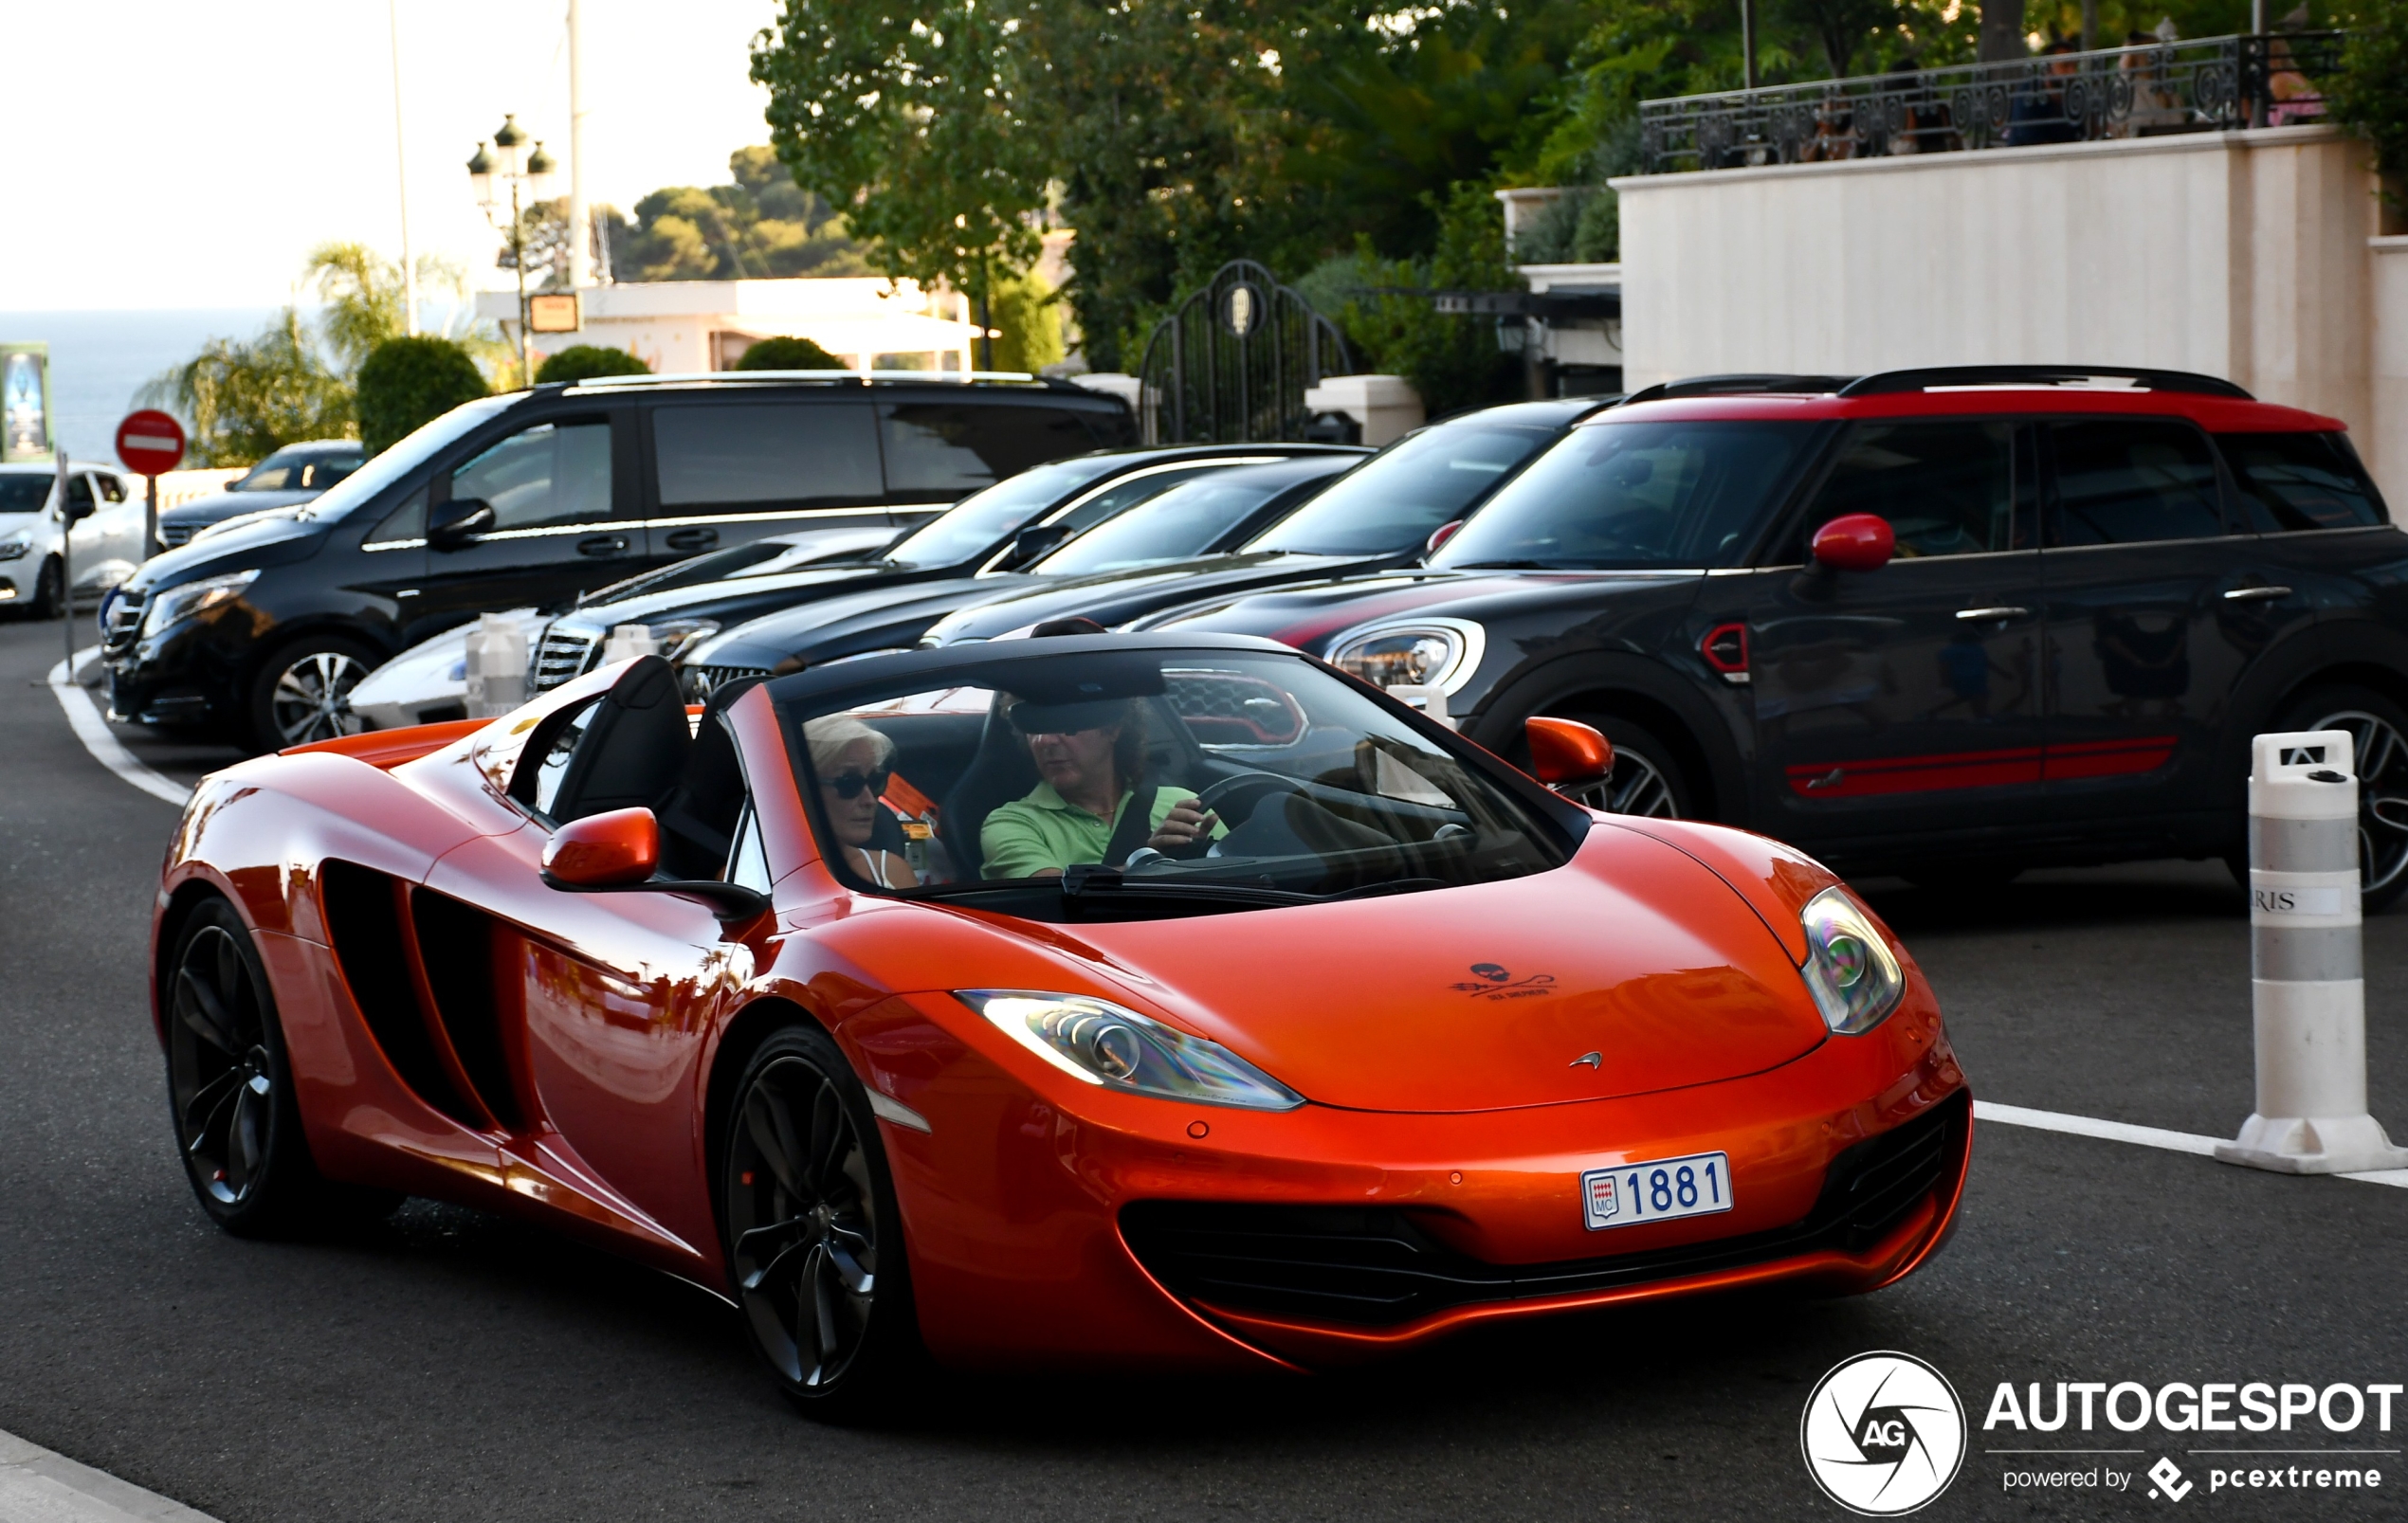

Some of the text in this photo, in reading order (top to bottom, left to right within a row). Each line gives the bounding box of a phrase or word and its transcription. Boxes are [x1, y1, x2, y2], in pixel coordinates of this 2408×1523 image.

[2253, 890, 2295, 912] RIS
[1628, 1161, 1719, 1215] 1881
[1596, 1199, 1614, 1212] MC
